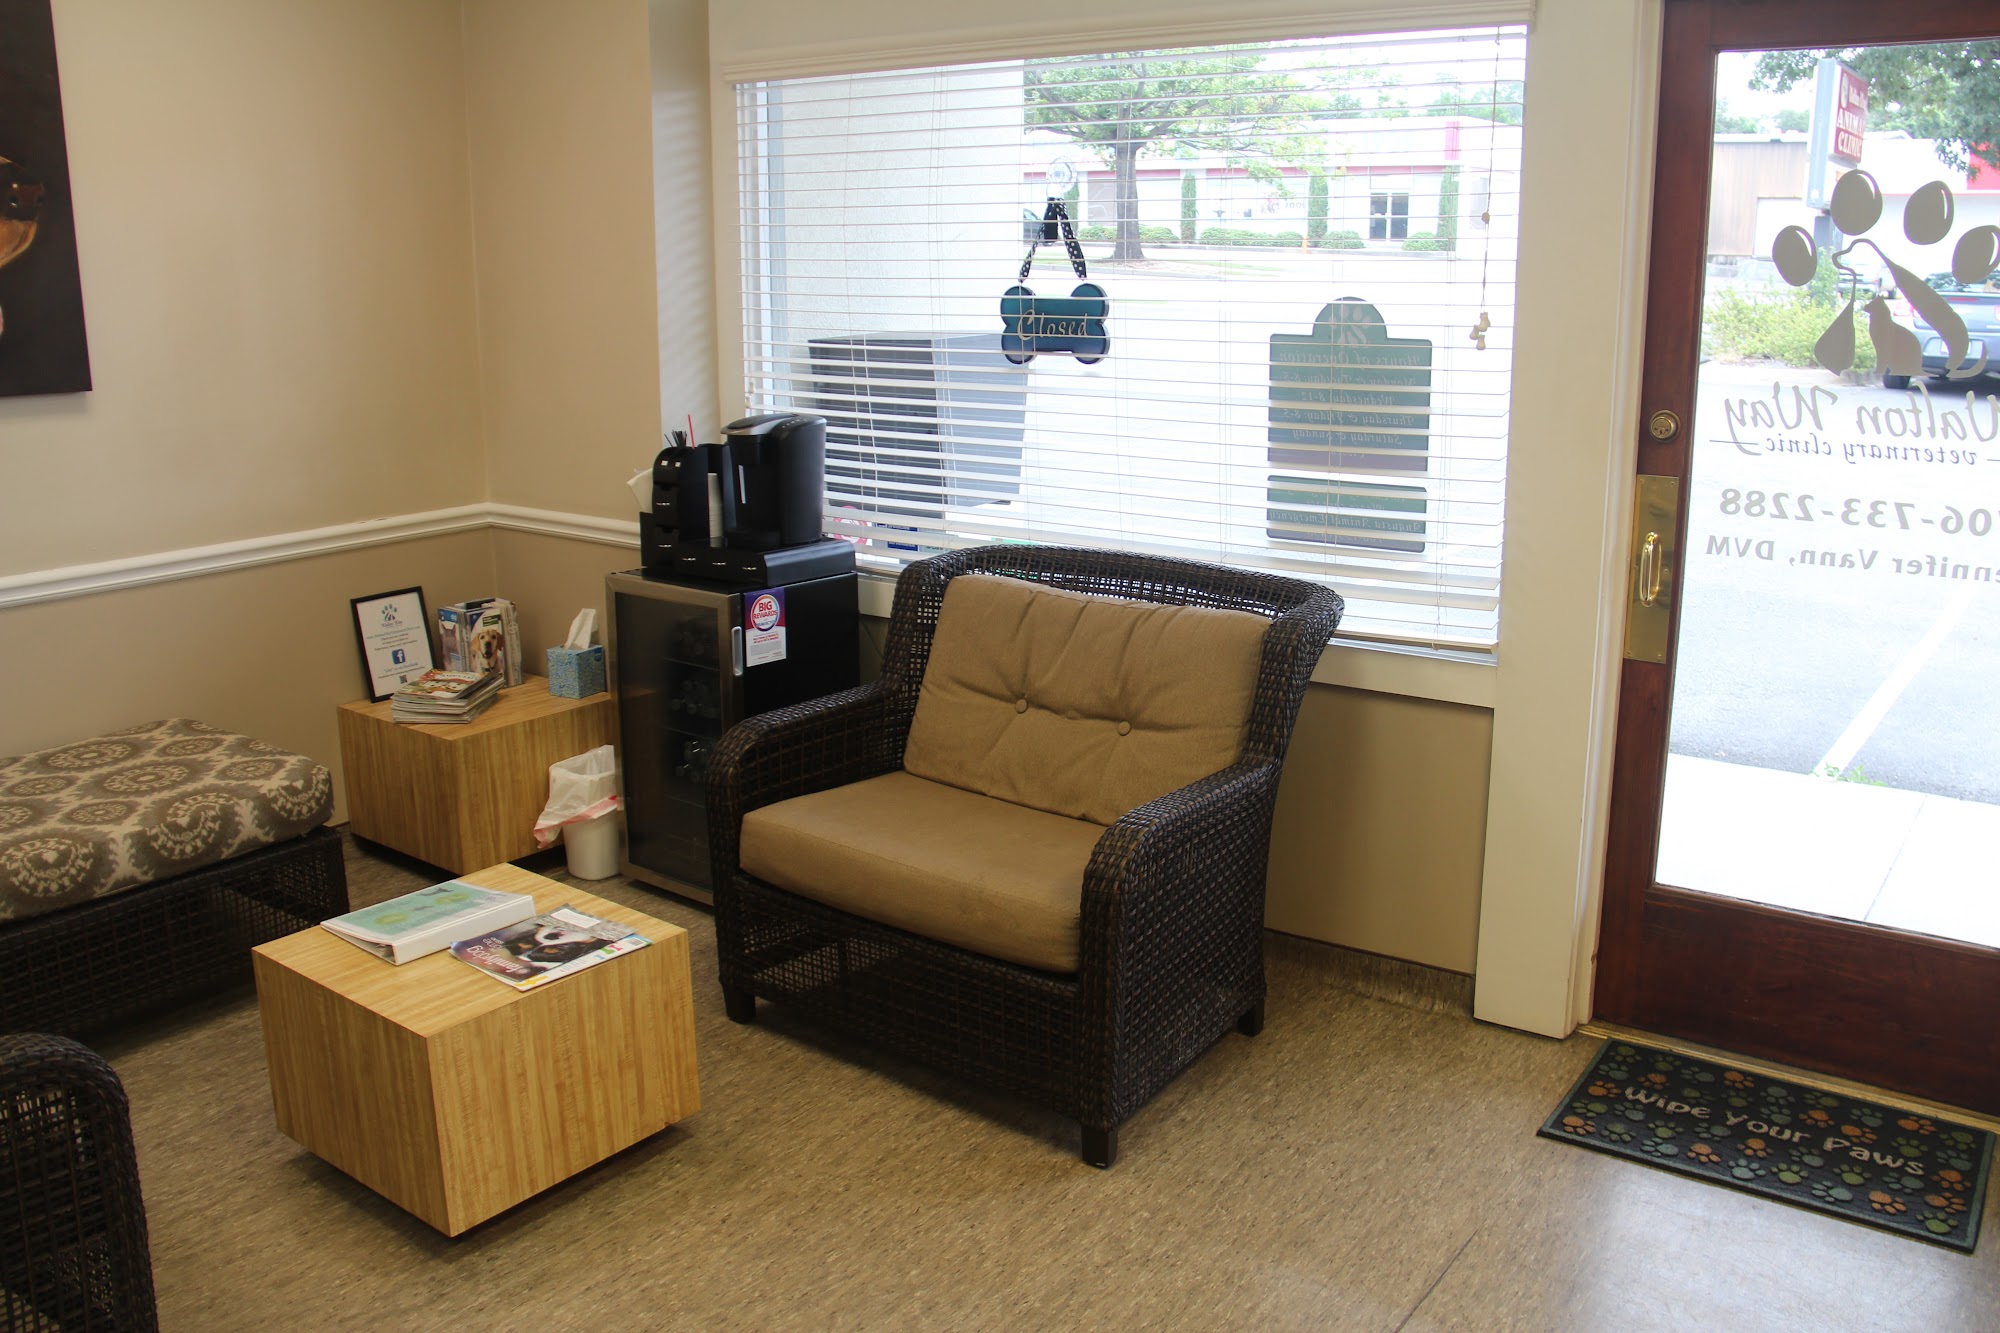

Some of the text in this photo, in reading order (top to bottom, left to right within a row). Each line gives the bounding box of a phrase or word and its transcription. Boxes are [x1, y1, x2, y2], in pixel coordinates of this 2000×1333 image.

[1837, 131, 1862, 158] CLINIC
[1017, 309, 1088, 341] Closed
[753, 609, 778, 620] REWARDS
[758, 600, 773, 612] BIG
